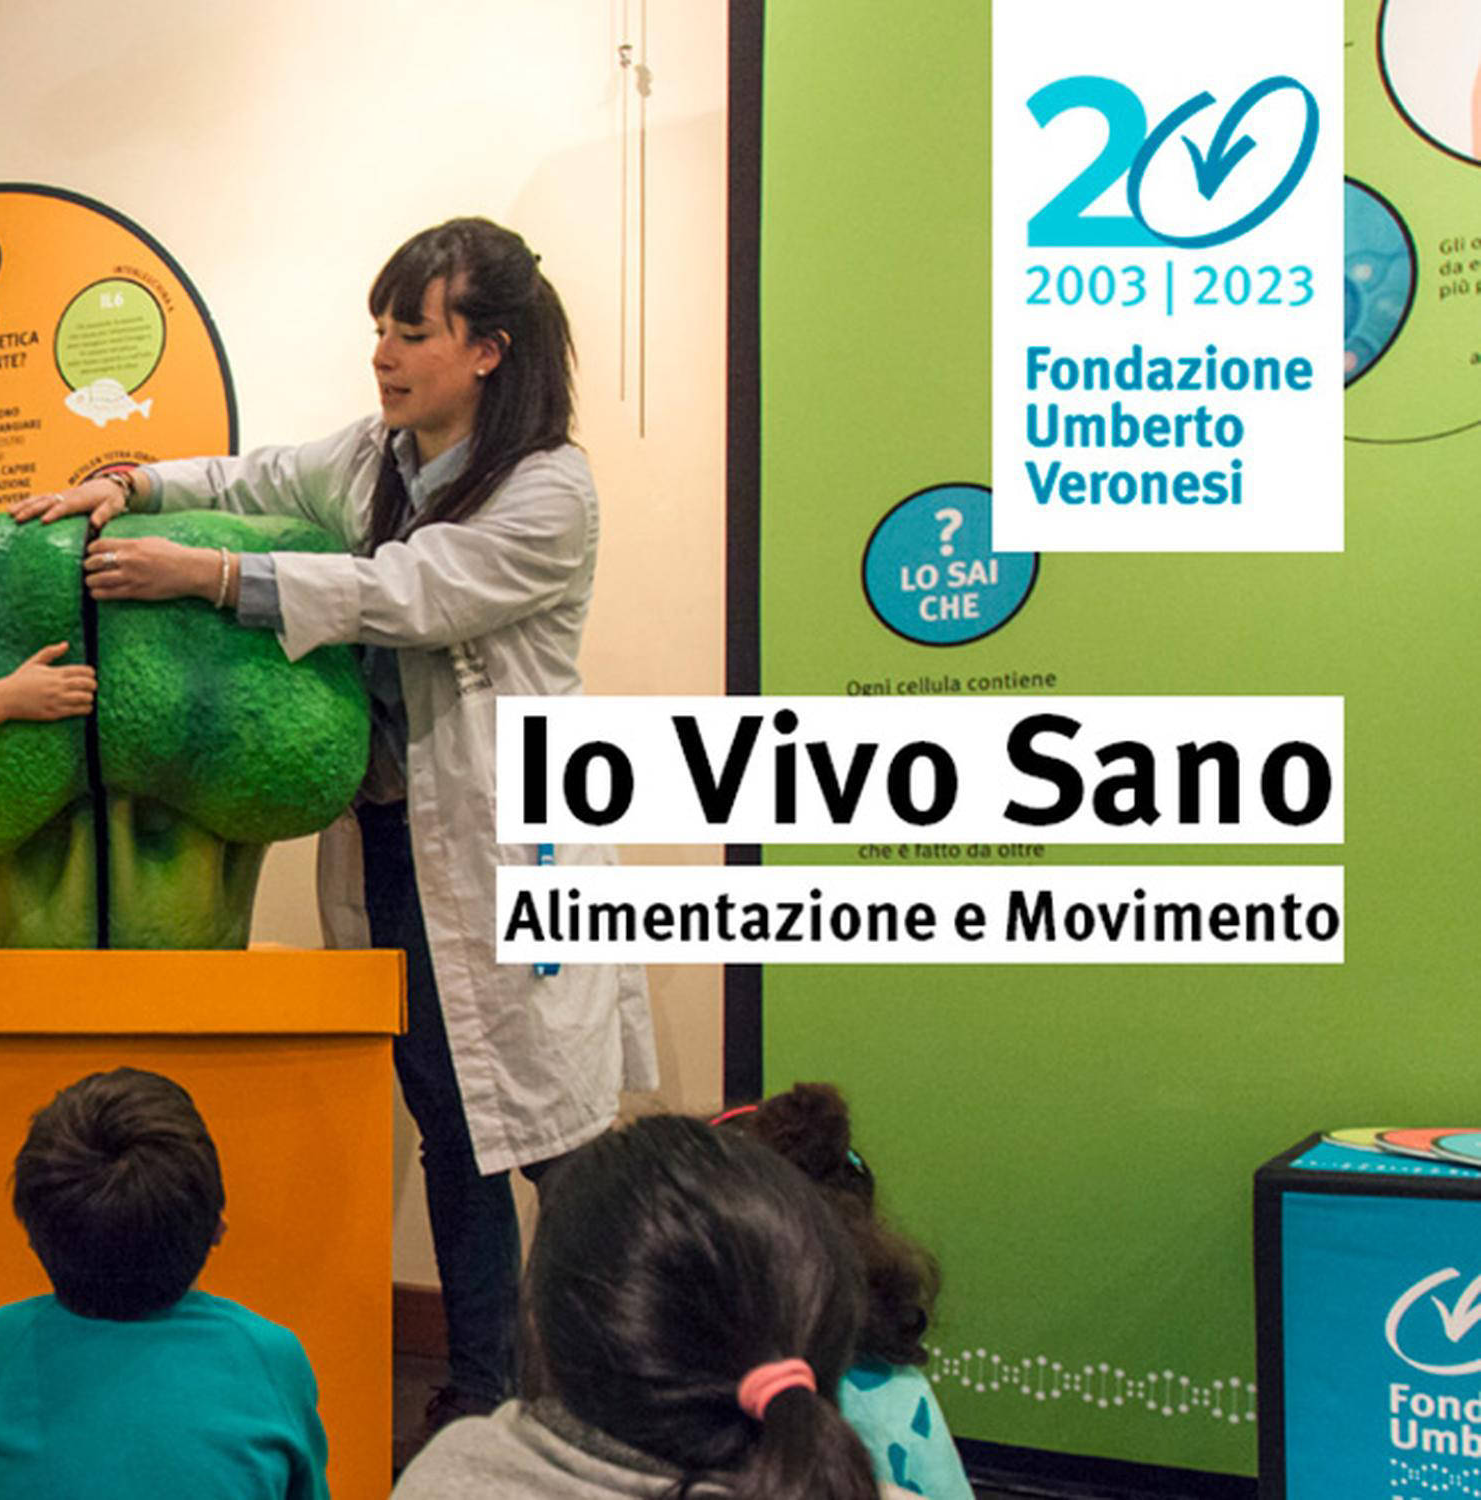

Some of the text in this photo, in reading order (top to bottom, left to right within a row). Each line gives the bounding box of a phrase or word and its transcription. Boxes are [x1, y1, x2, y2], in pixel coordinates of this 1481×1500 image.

[1439, 236, 1466, 255] Gli
[1439, 259, 1464, 276] da
[1439, 279, 1469, 303] più
[934, 507, 964, 557] ?
[900, 558, 998, 591] LO SAI
[919, 592, 980, 622] CHE
[846, 670, 1058, 696] Ogni cellula contiene
[859, 845, 891, 858] che
[967, 845, 992, 858] da
[998, 845, 1046, 858] oltre
